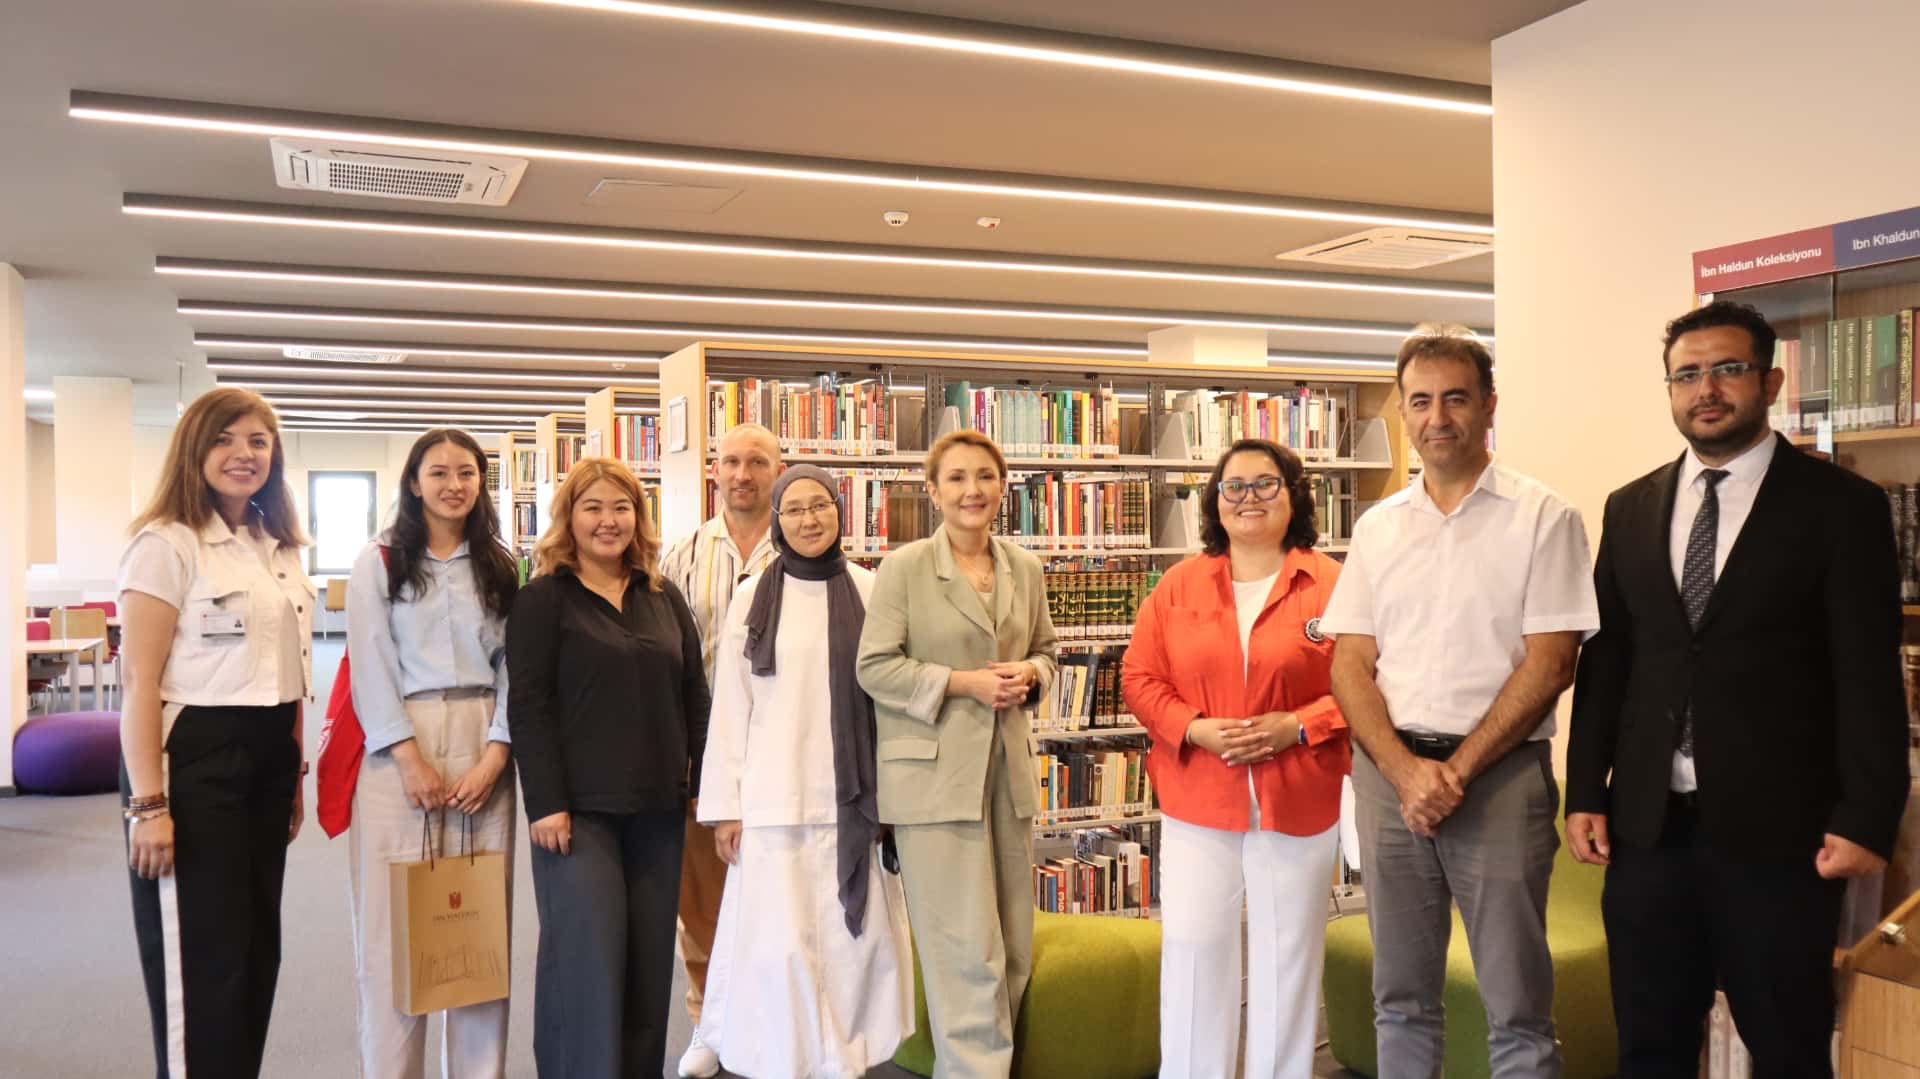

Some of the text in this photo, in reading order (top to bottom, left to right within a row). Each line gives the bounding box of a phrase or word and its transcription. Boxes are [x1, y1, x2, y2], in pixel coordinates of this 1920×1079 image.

[1852, 229, 1920, 251] Ibn Khaldun
[1718, 260, 1754, 274] Haldun
[1756, 247, 1822, 268] Koleksiyonu
